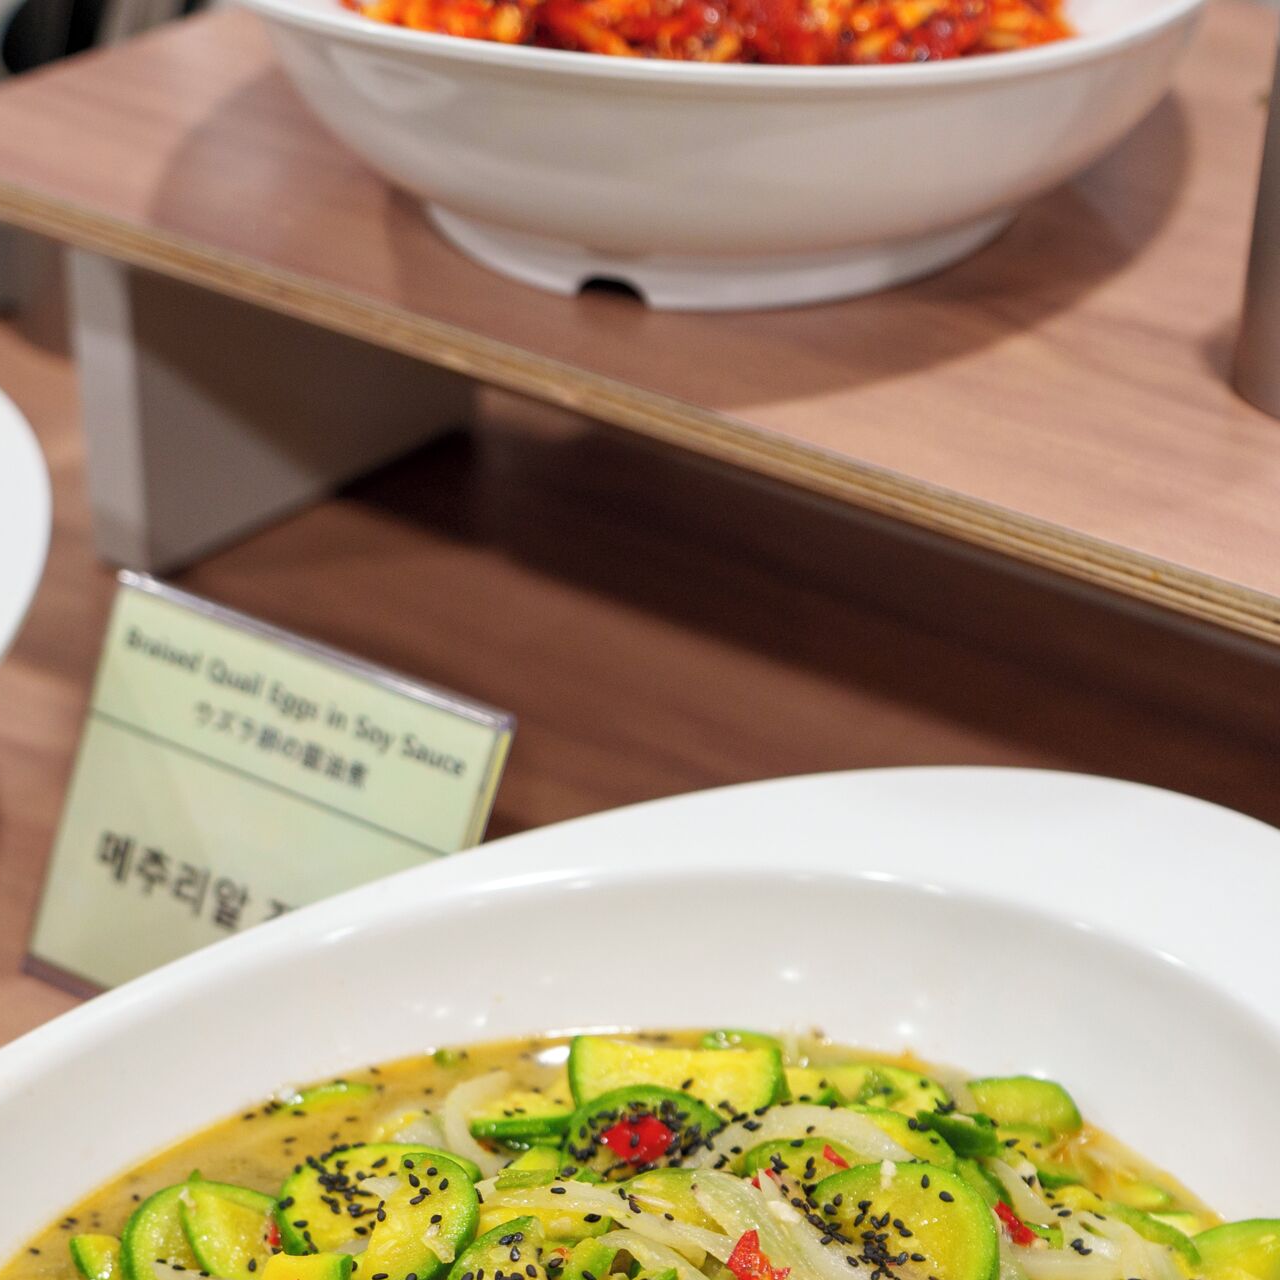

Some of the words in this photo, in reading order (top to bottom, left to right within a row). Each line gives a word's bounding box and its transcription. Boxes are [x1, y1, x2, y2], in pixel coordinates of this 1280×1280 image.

[126, 626, 202, 674] Braised
[207, 657, 265, 698] Quail
[269, 680, 318, 721] Eggs
[326, 703, 348, 731] in
[355, 714, 395, 755] Soy
[402, 733, 467, 776] Sauce
[98, 831, 248, 930] 메추리알
